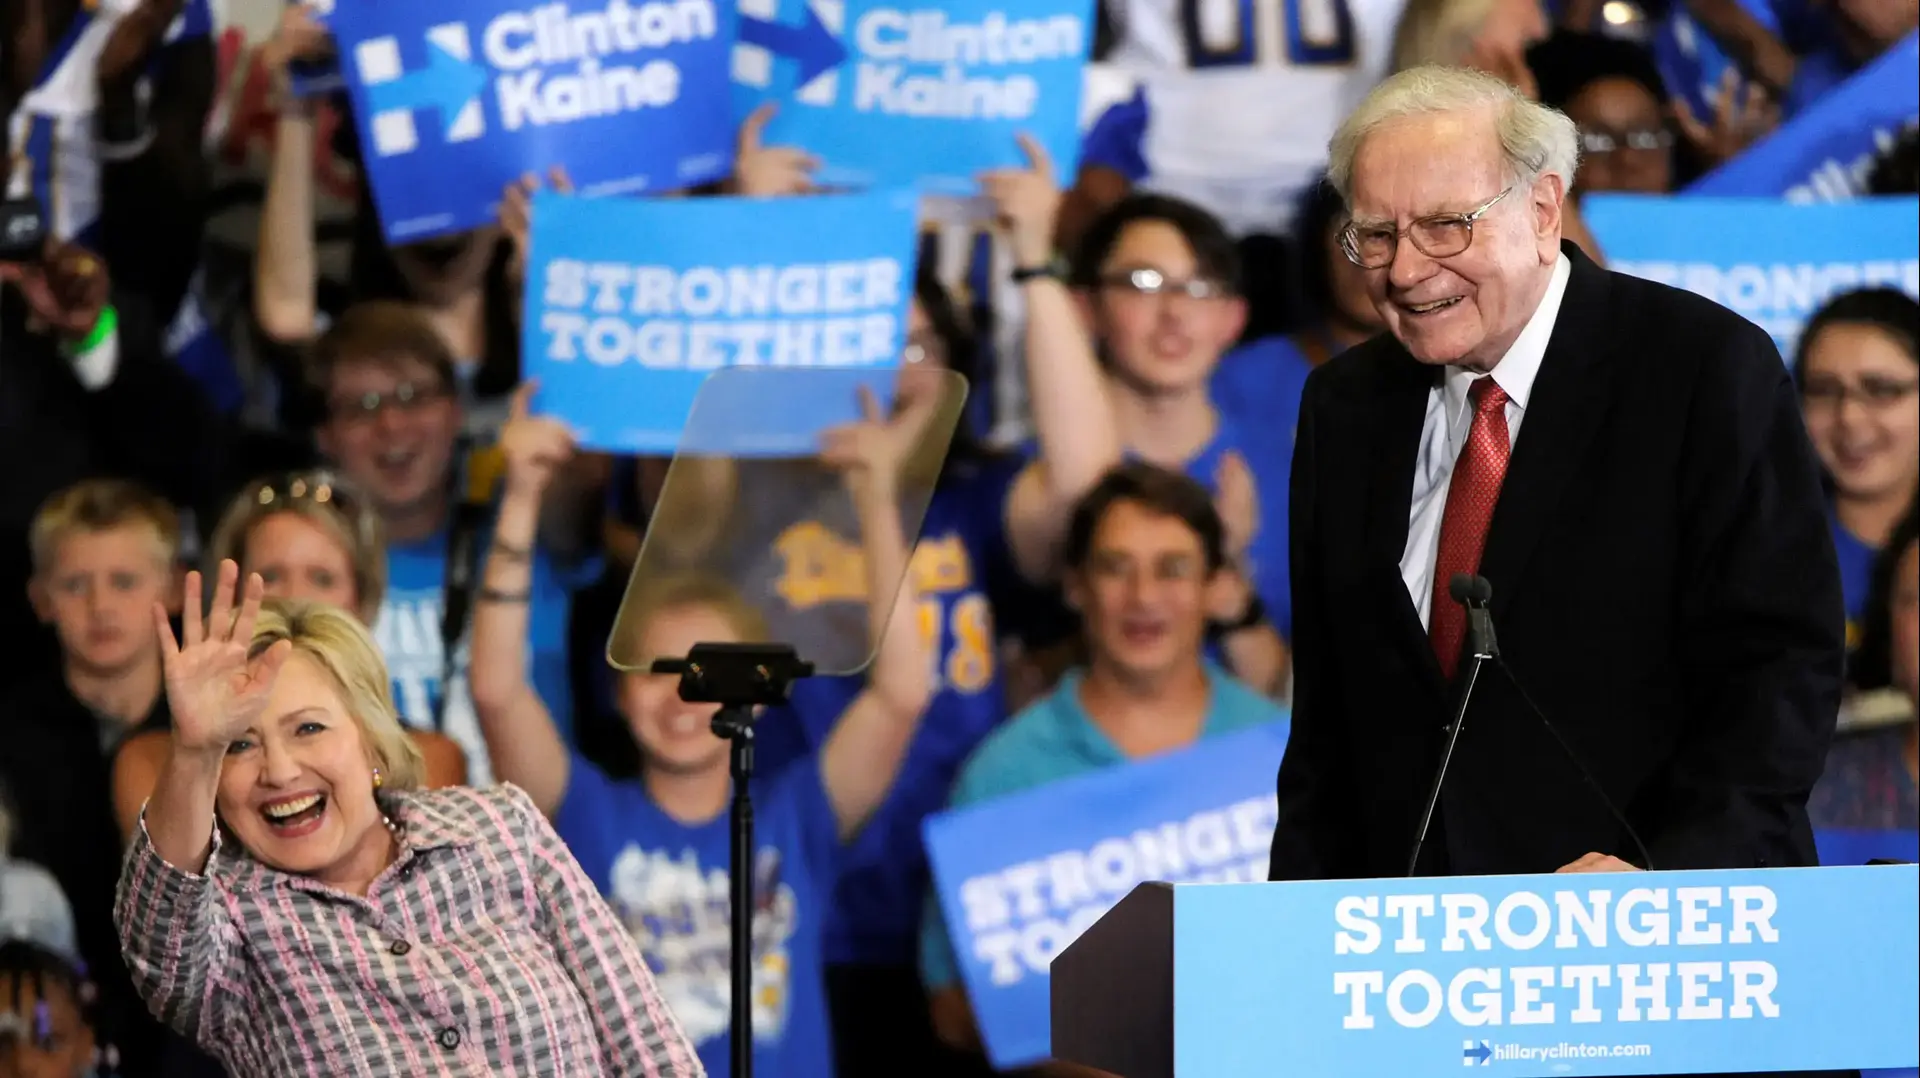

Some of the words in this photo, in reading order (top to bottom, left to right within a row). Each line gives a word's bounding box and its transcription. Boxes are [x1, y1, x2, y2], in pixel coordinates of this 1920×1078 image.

[484, 0, 716, 70] Clinton
[855, 9, 1082, 66] Clinton
[495, 57, 682, 130] Kaine
[854, 62, 1040, 120] Kaine
[544, 258, 900, 316] STRONGER
[1606, 261, 1919, 311] TRONG
[542, 311, 897, 369] TOGETHER
[960, 793, 1278, 932] STRONGE
[1333, 885, 1780, 955] STRONGER
[1333, 960, 1780, 1030] TOGETHER
[1494, 1042, 1652, 1062] hillaryclinton.com
